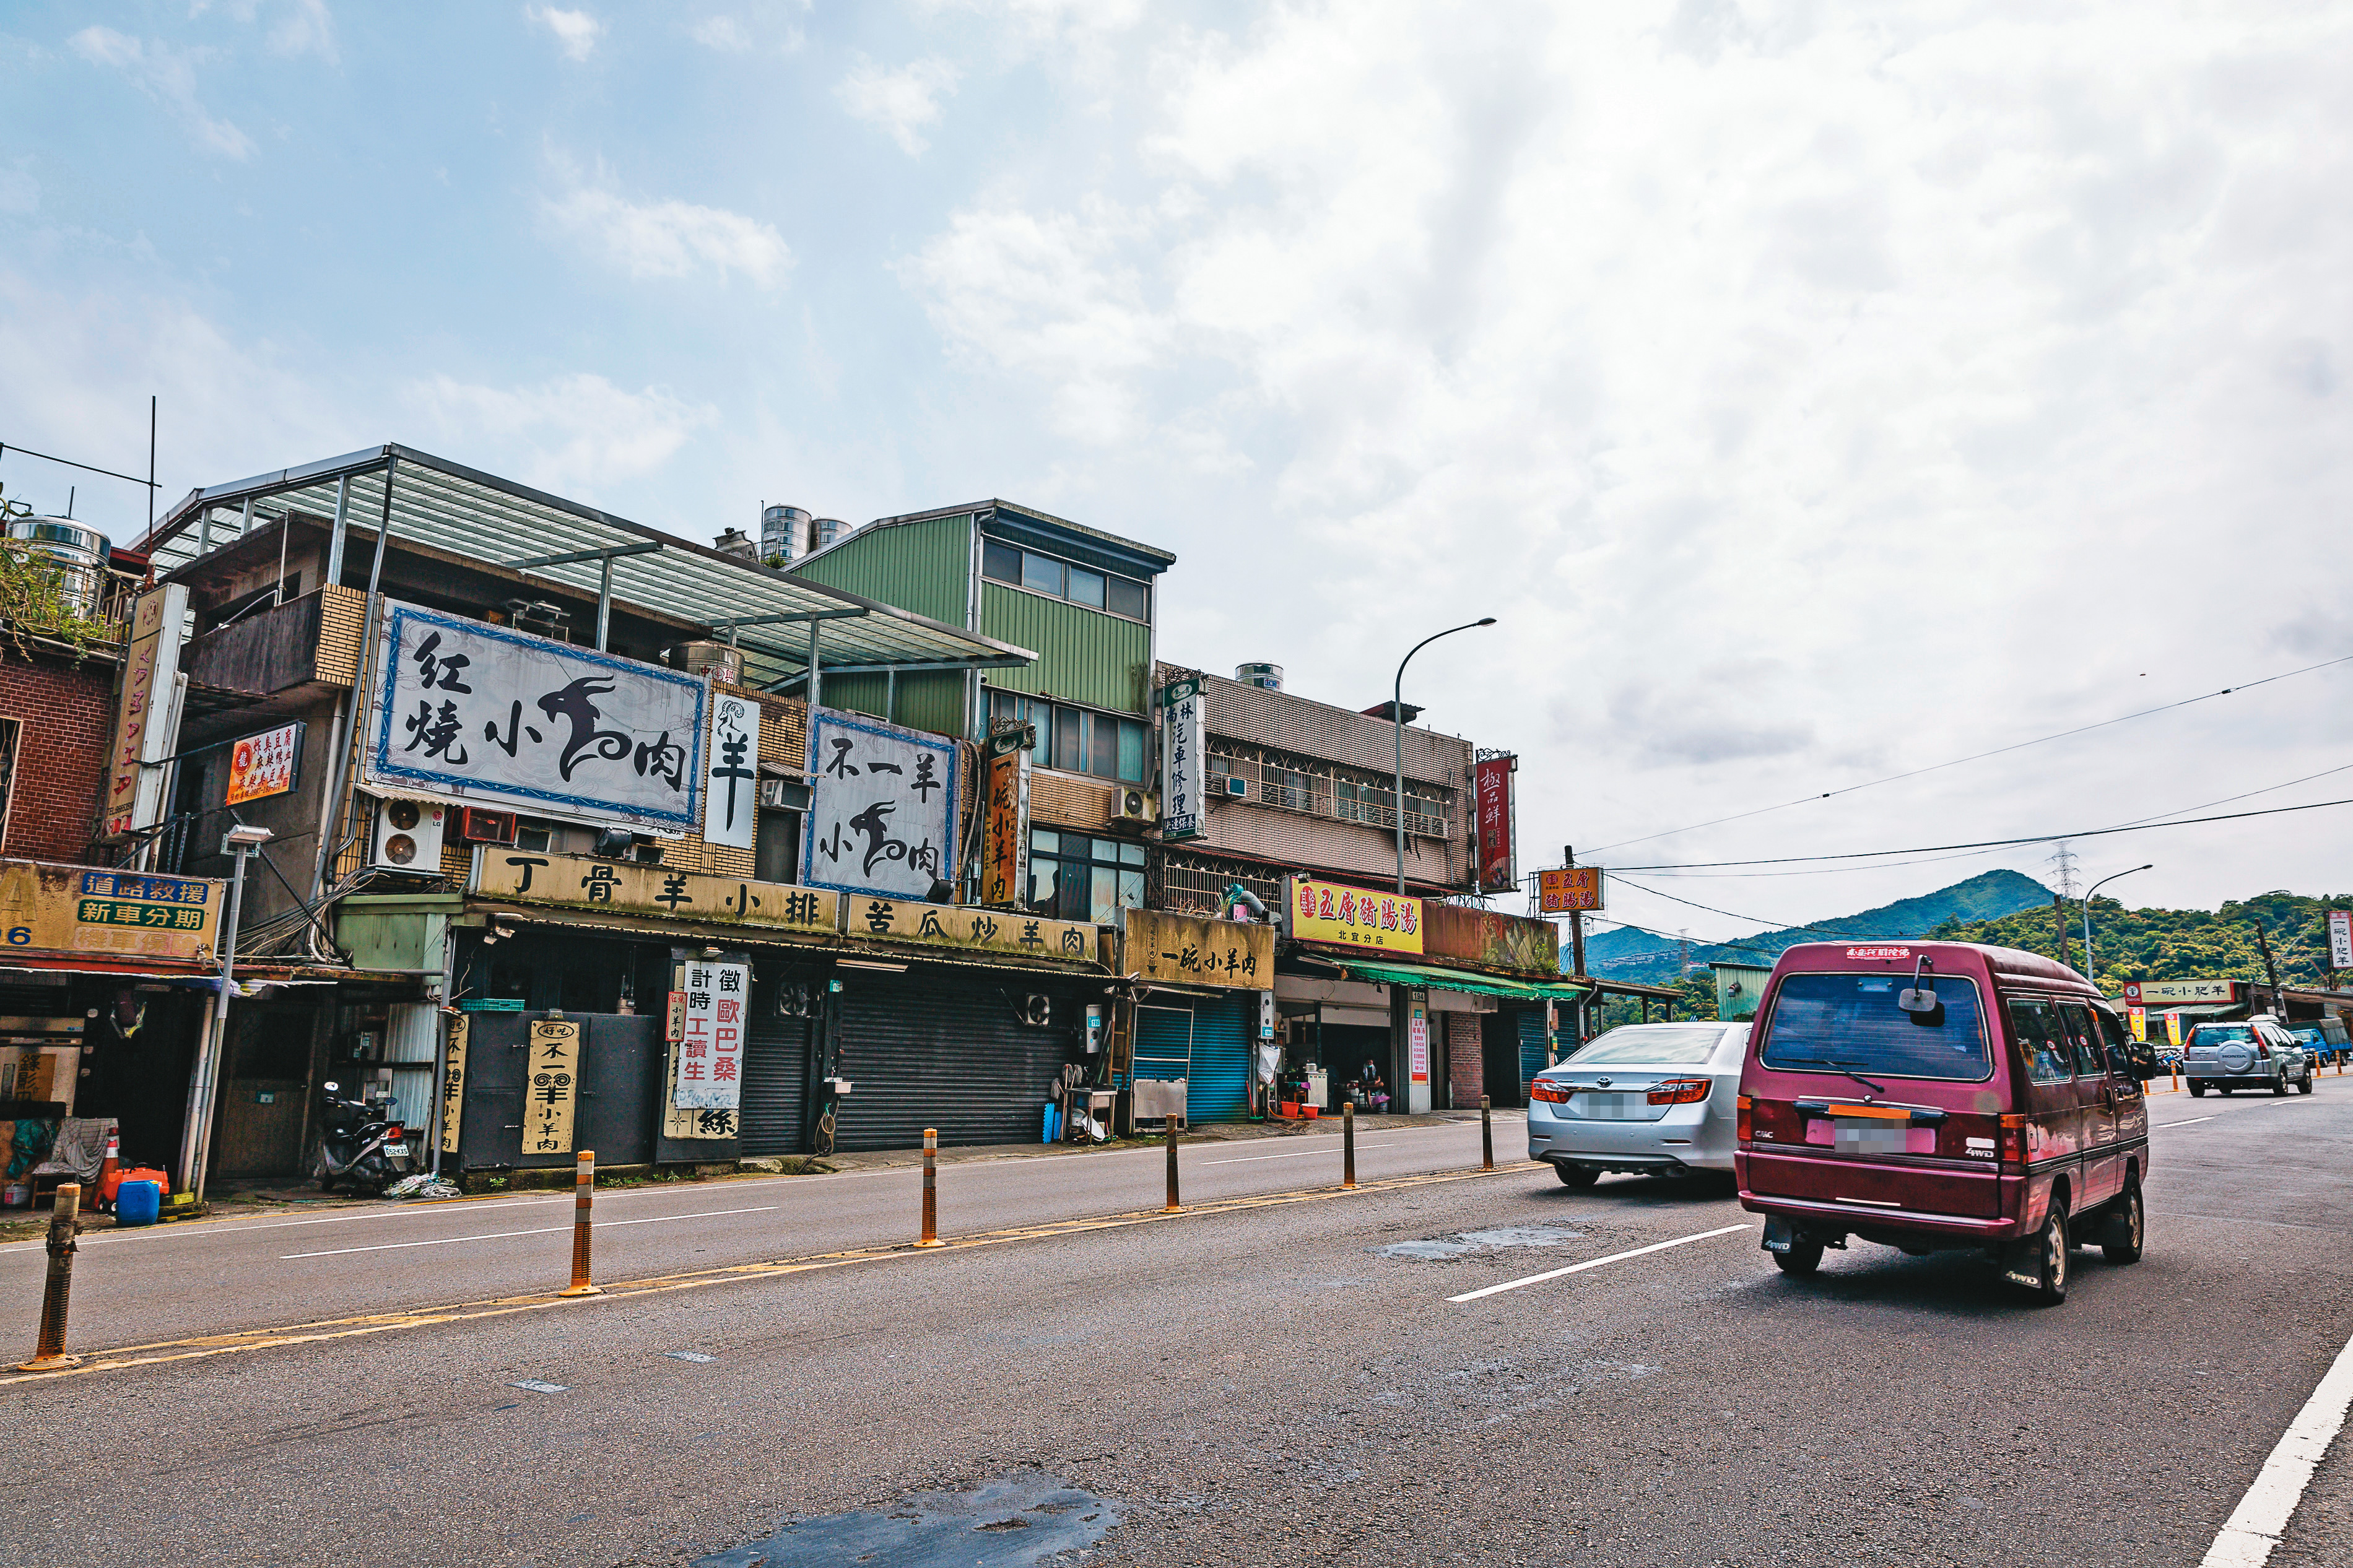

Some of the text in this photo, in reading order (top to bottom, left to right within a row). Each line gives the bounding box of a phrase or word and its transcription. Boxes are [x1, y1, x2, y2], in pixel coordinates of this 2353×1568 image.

[404, 630, 472, 765] 紅燒
[253, 728, 292, 755] 炸臭豆腐
[238, 751, 248, 768] 龍
[254, 747, 291, 771] 麻辣鴨血
[825, 738, 940, 803] 不一羊
[1172, 722, 1187, 815] 汽車修理
[236, 764, 285, 792] 麻辣臭豆腐
[711, 732, 755, 832] 羊
[1480, 768, 1501, 827] 極品鮮
[991, 760, 1011, 900] 一碗小羊肉
[87, 875, 205, 903] 道路救援
[505, 856, 820, 926] 丁骨羊小排
[1562, 871, 1590, 888] 五層
[1300, 890, 1316, 914] 基隆
[1319, 888, 1417, 935] 五層豬腸湯
[1545, 890, 1596, 908] 豬腸湯
[82, 902, 201, 929] 新車分期
[864, 901, 1084, 955] 苦瓜炒羊肉
[0, 927, 31, 946] 6
[78, 930, 199, 955] 機車保險
[1338, 930, 1383, 945] 北宜分店
[2333, 921, 2349, 965] 一碗小肥羊
[1162, 942, 1256, 979] 一碗小羊肉
[1414, 992, 1424, 1000] 194
[2146, 985, 2225, 996] 一碗小肥羊
[543, 1027, 569, 1036] 好吃
[671, 1007, 682, 1037] 小羊肉
[684, 969, 713, 1080] 計時工讀生
[714, 969, 741, 1081] 徵歐巴桑
[1965, 1147, 1994, 1158] 4WD
[1765, 1240, 1790, 1250] 4WD
[2006, 1270, 2038, 1284] 4WD
